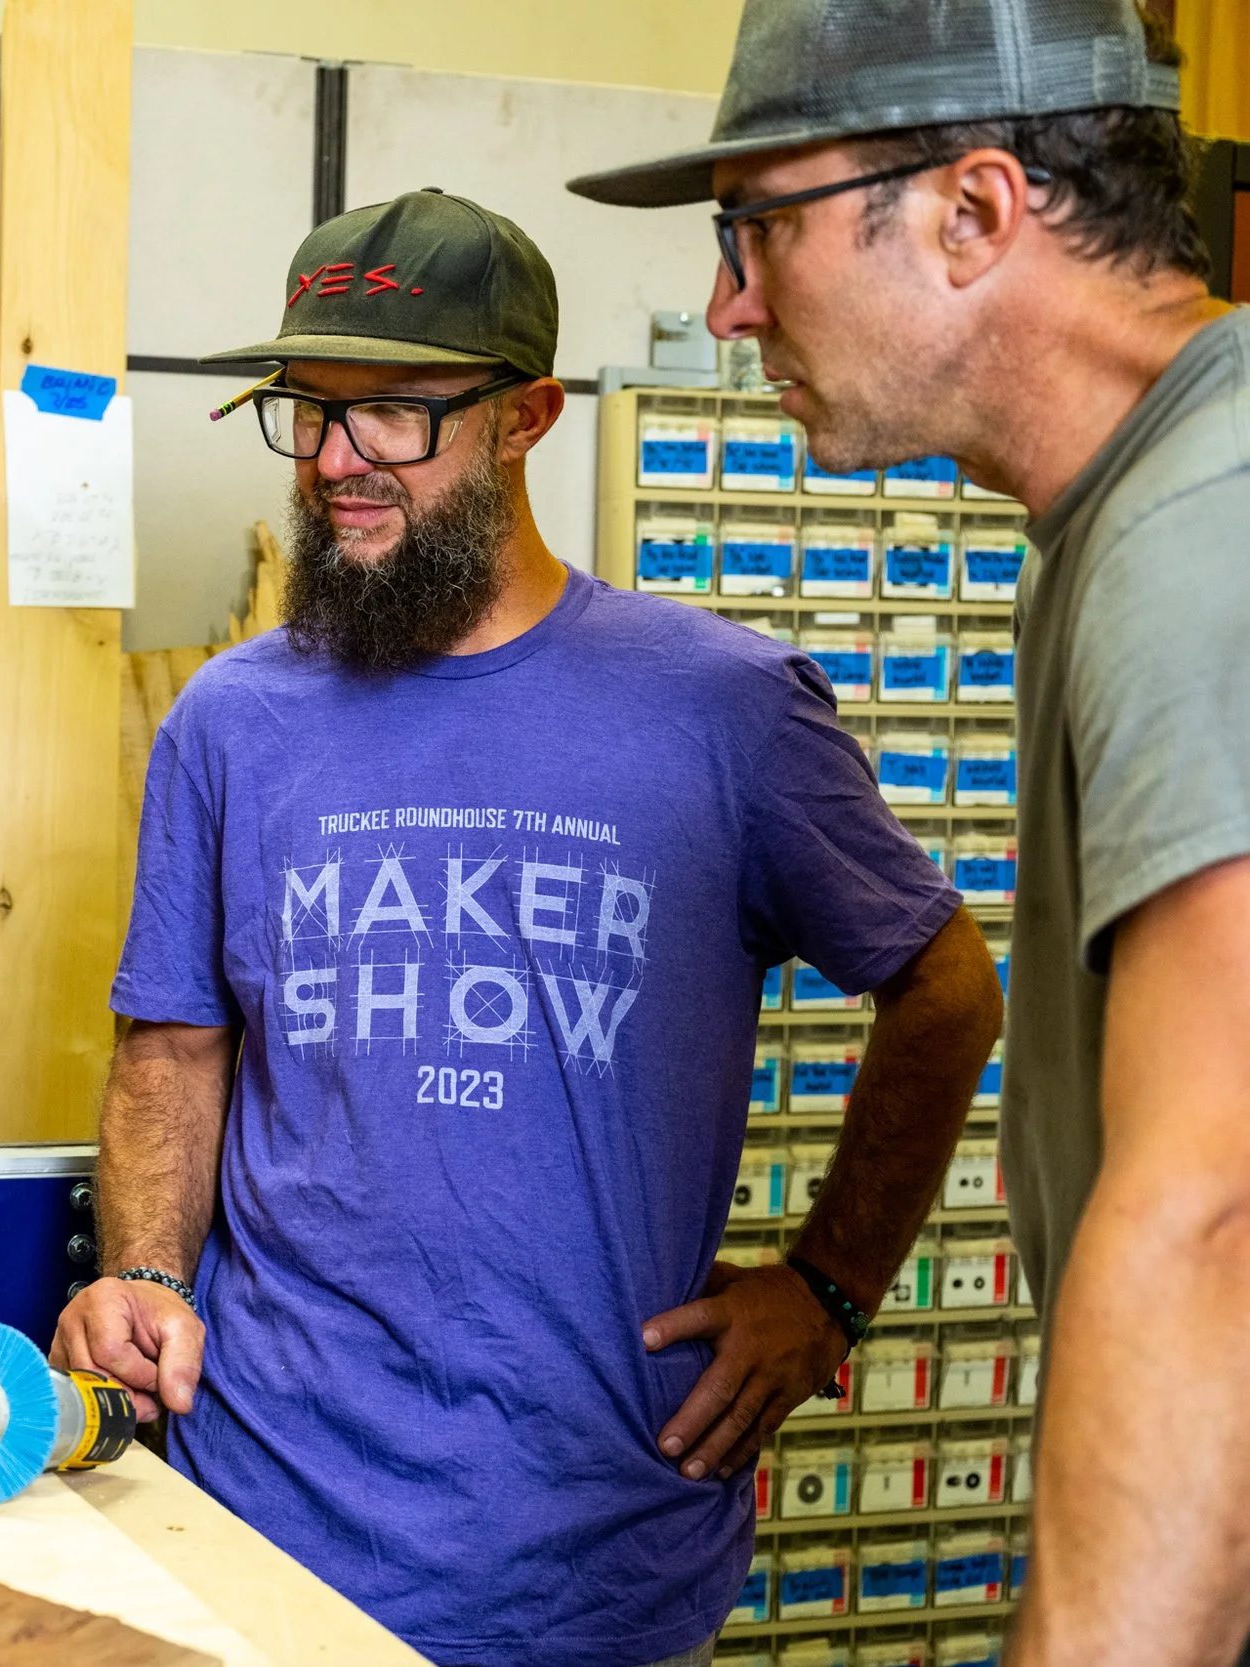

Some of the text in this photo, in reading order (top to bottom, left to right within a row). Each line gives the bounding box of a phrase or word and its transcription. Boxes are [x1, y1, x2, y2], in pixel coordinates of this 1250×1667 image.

[288, 263, 424, 308] YES.
[318, 807, 621, 846] TRUCKEE ROUNDHOUSE 7TH ANNUAL
[281, 856, 651, 960] MAKER
[282, 962, 641, 1063] SHOW
[416, 1065, 504, 1110] 2023
